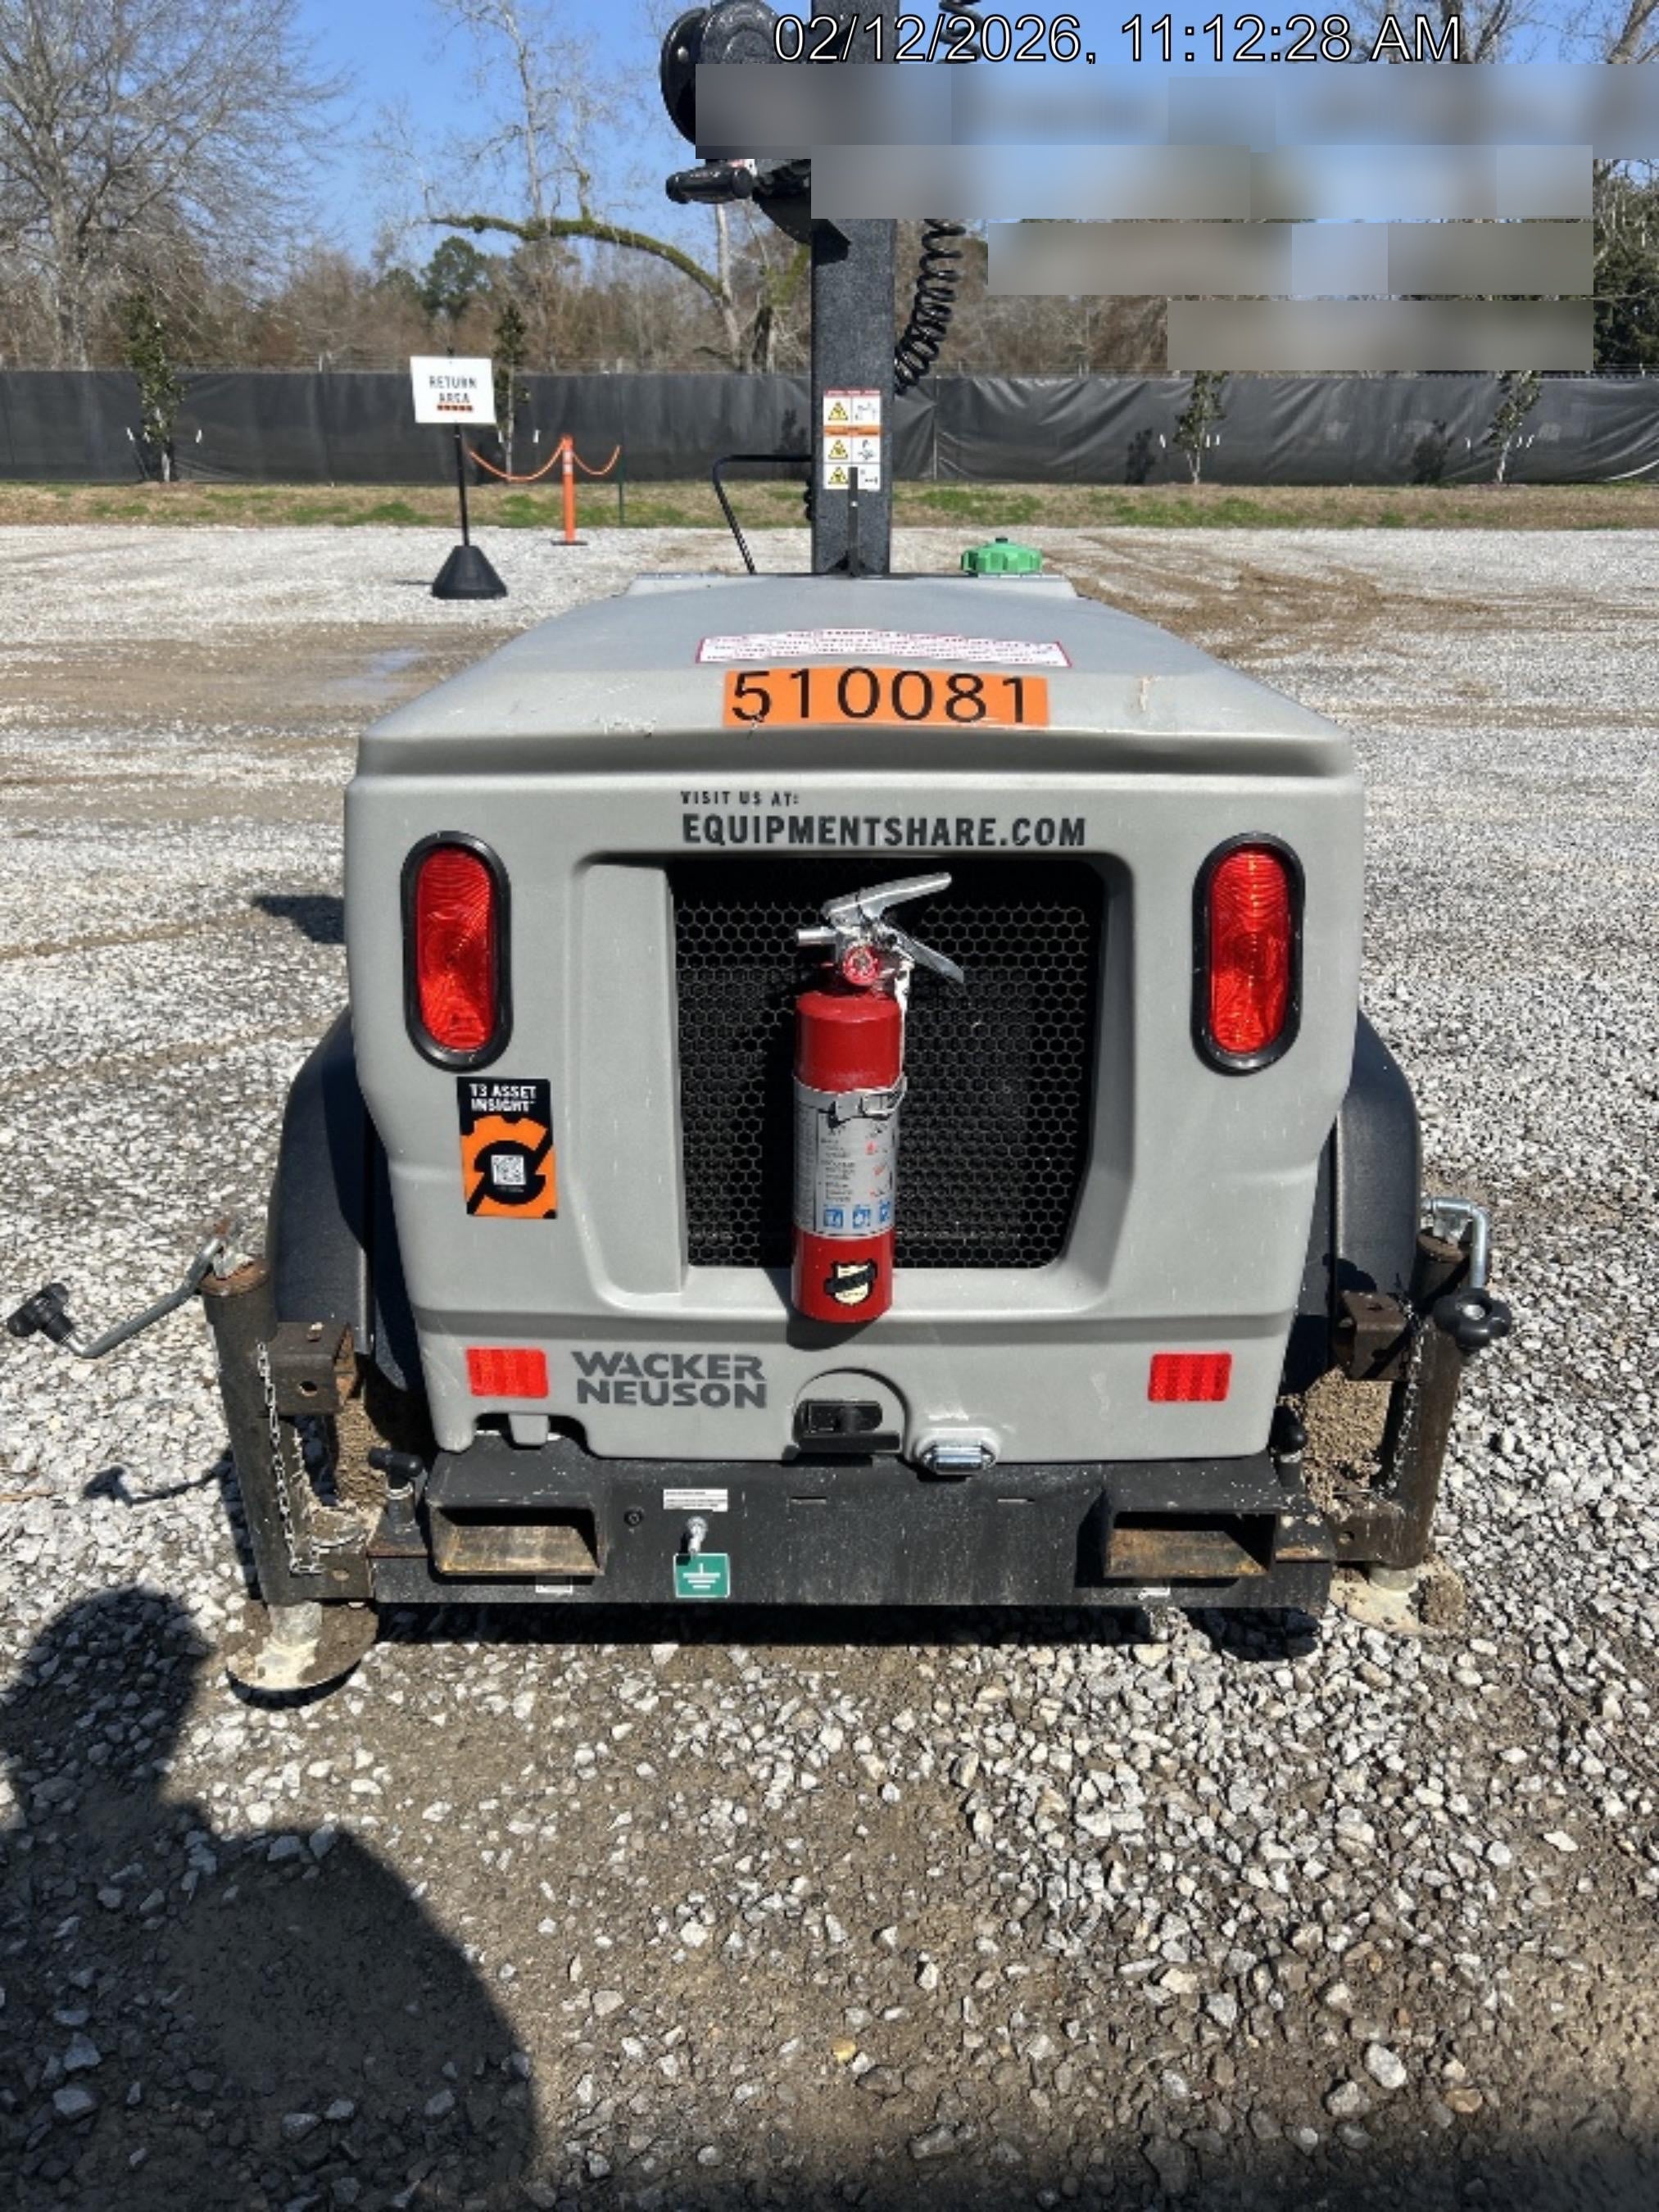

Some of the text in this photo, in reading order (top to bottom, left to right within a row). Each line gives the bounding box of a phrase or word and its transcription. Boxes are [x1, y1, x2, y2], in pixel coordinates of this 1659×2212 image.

[429, 375, 477, 388] RETURN
[438, 392, 470, 403] AREA
[732, 666, 1025, 723] 510081
[680, 791, 800, 807] VISIT US AT:
[682, 813, 1086, 847] EQUIPMENTSHARE.COM
[469, 1083, 537, 1099] T3 ASSET
[572, 1352, 767, 1380] WACKER
[577, 1378, 768, 1409] NEUSON
